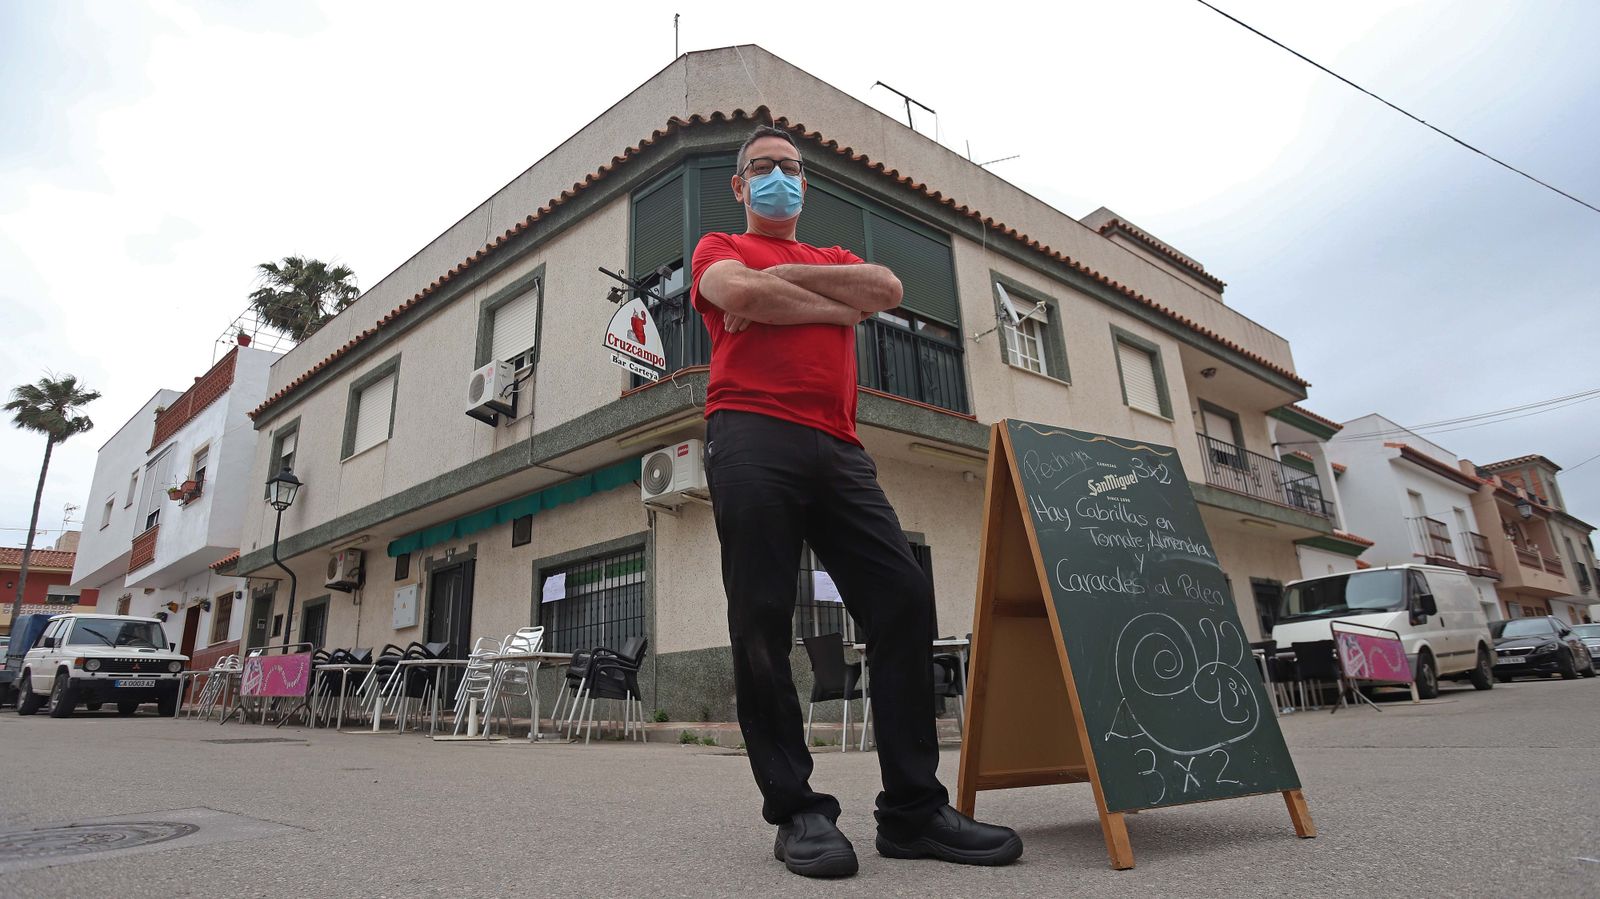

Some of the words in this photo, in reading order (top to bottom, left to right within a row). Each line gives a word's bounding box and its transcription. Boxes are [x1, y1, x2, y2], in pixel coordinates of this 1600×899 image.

[608, 333, 665, 367] Cruzcampo
[612, 355, 626, 367] Bar
[629, 363, 658, 380] Carteya
[1030, 494, 1071, 532] Hay
[1075, 497, 1149, 527] Cabrillas
[1156, 516, 1176, 532] en
[1056, 558, 1146, 594] Caracoles
[1154, 576, 1173, 596] al
[1177, 573, 1224, 606] Poleo
